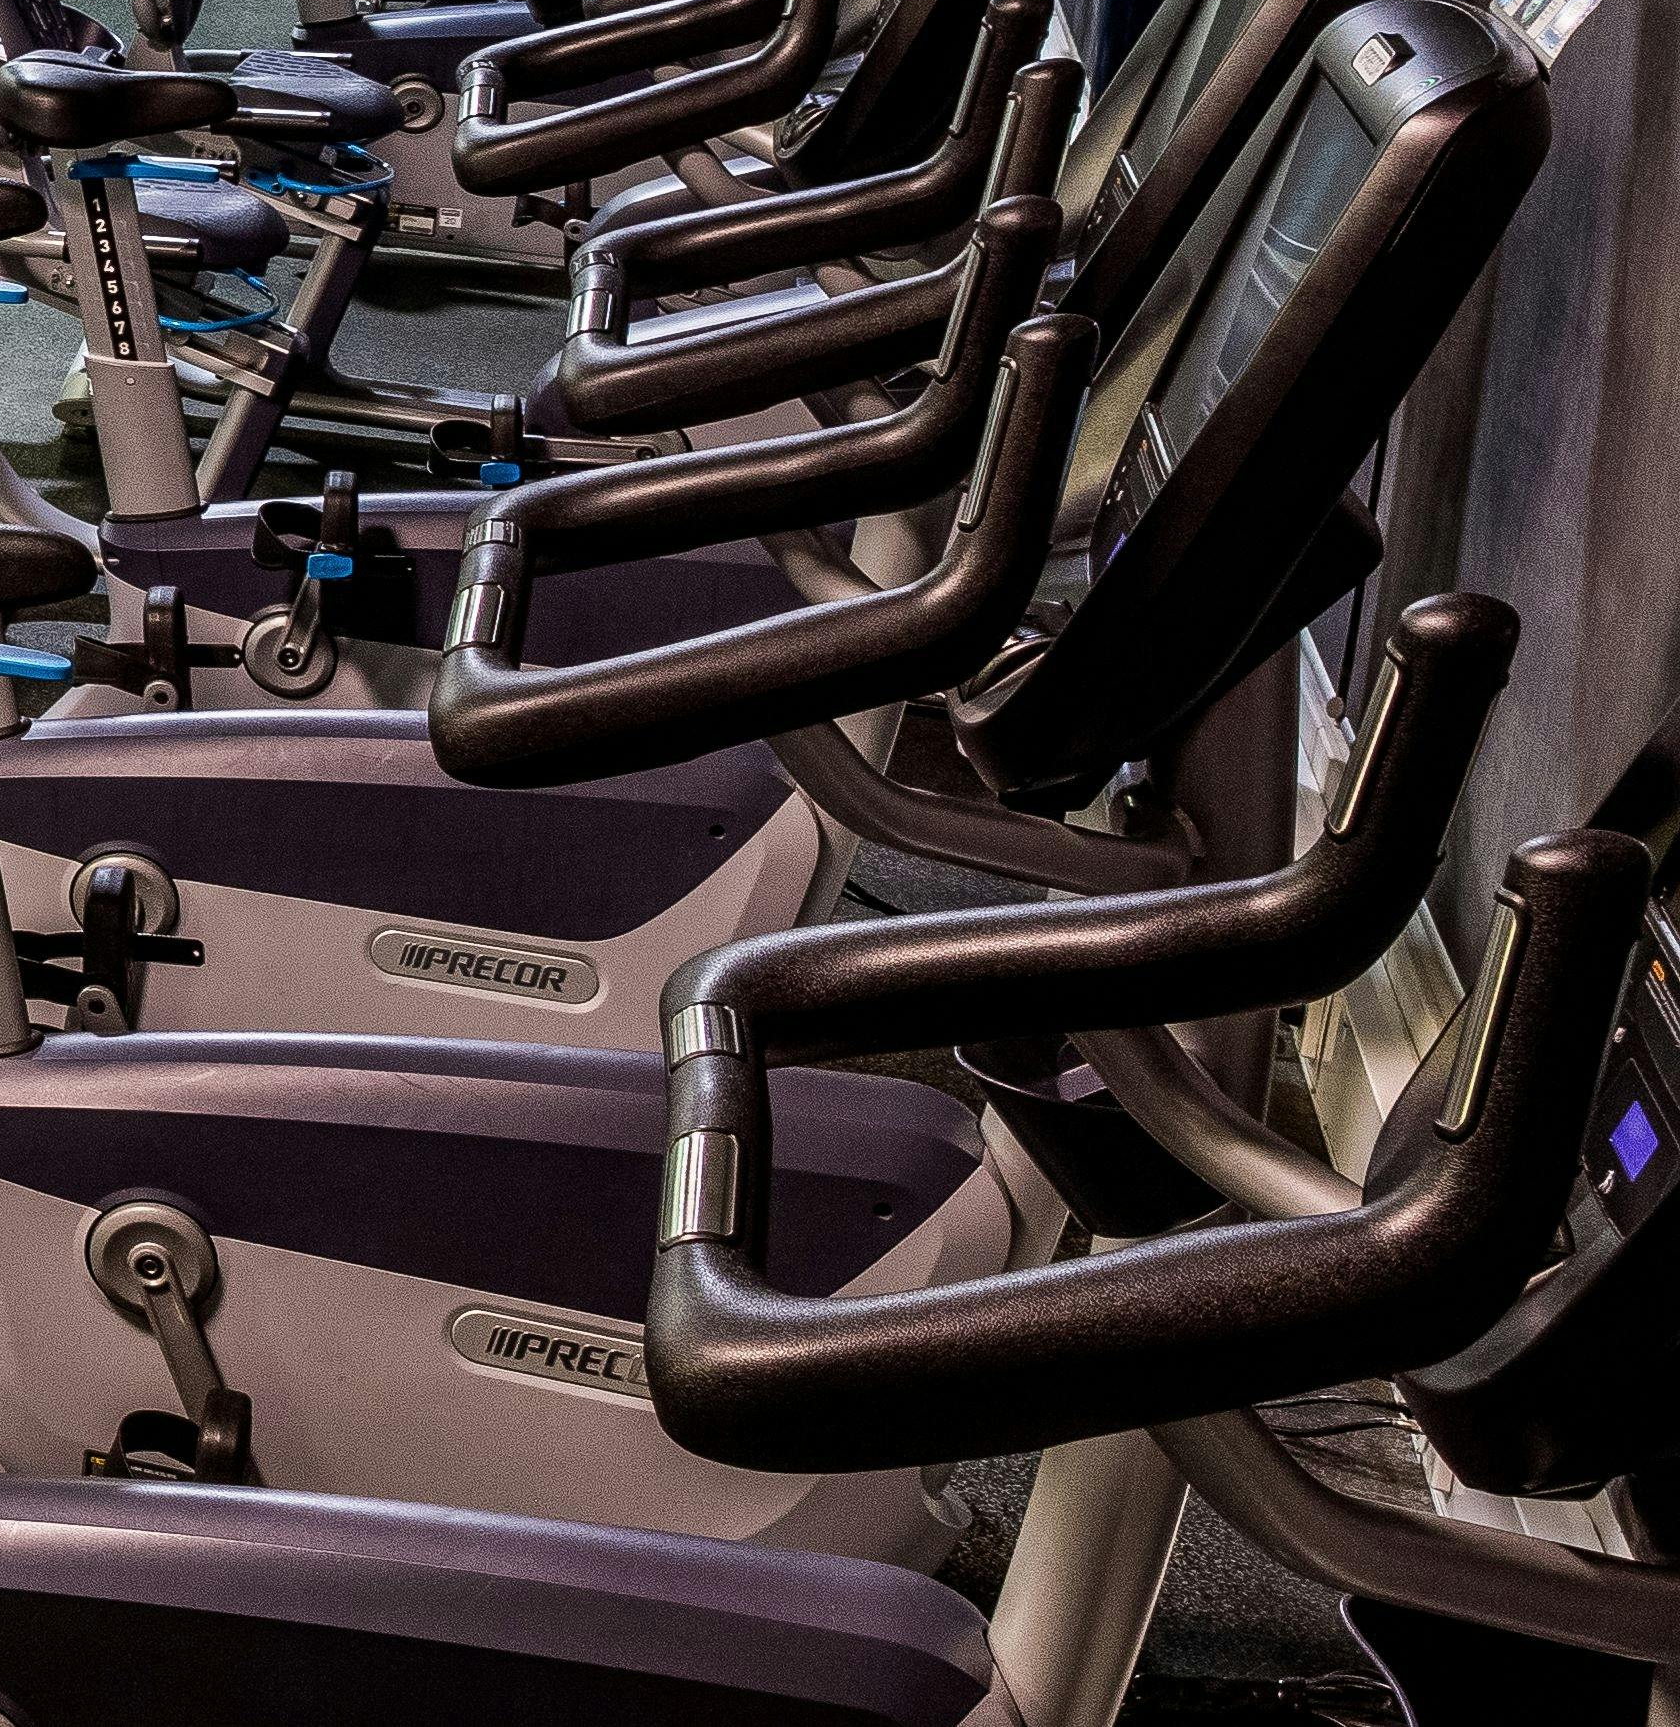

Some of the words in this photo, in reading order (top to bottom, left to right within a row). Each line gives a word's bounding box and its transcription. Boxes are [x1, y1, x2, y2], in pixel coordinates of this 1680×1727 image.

[92, 198, 102, 212] 1
[95, 218, 107, 233] 2
[99, 239, 111, 253] 3
[103, 259, 115, 273] 4
[106, 279, 119, 294] 5
[111, 300, 123, 315] 6
[113, 320, 126, 335] 7
[118, 341, 131, 356] 8
[423, 945, 568, 992] PRECOR
